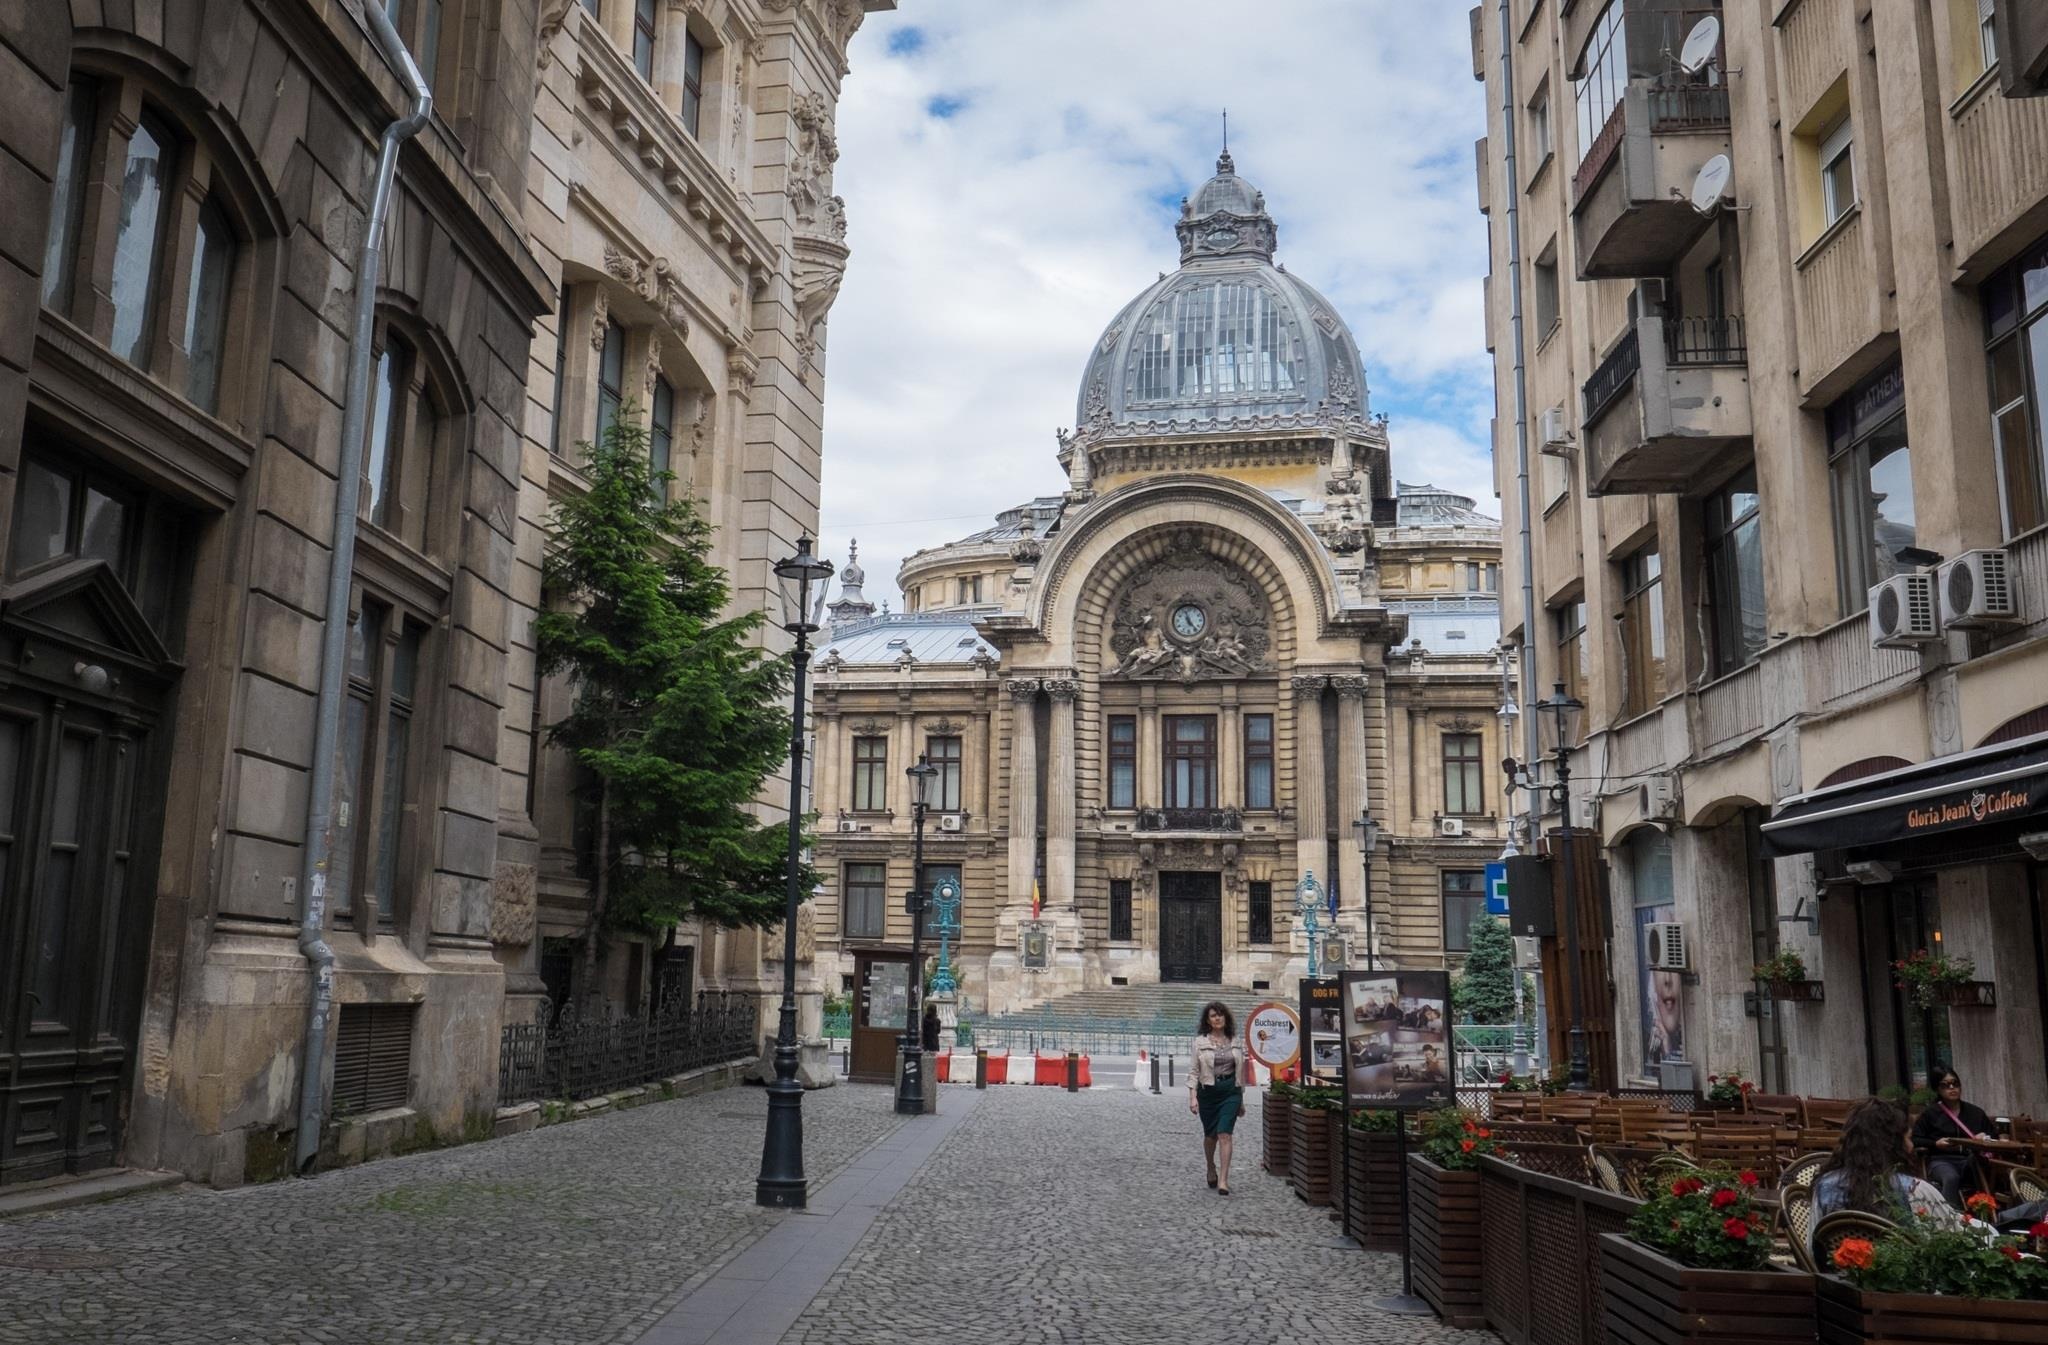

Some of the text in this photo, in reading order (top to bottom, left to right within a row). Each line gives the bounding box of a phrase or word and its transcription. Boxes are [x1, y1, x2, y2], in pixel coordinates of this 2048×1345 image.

[1908, 789, 2028, 828] Gloria Jean's Coffees
[1254, 1018, 1289, 1027] Bucharest
